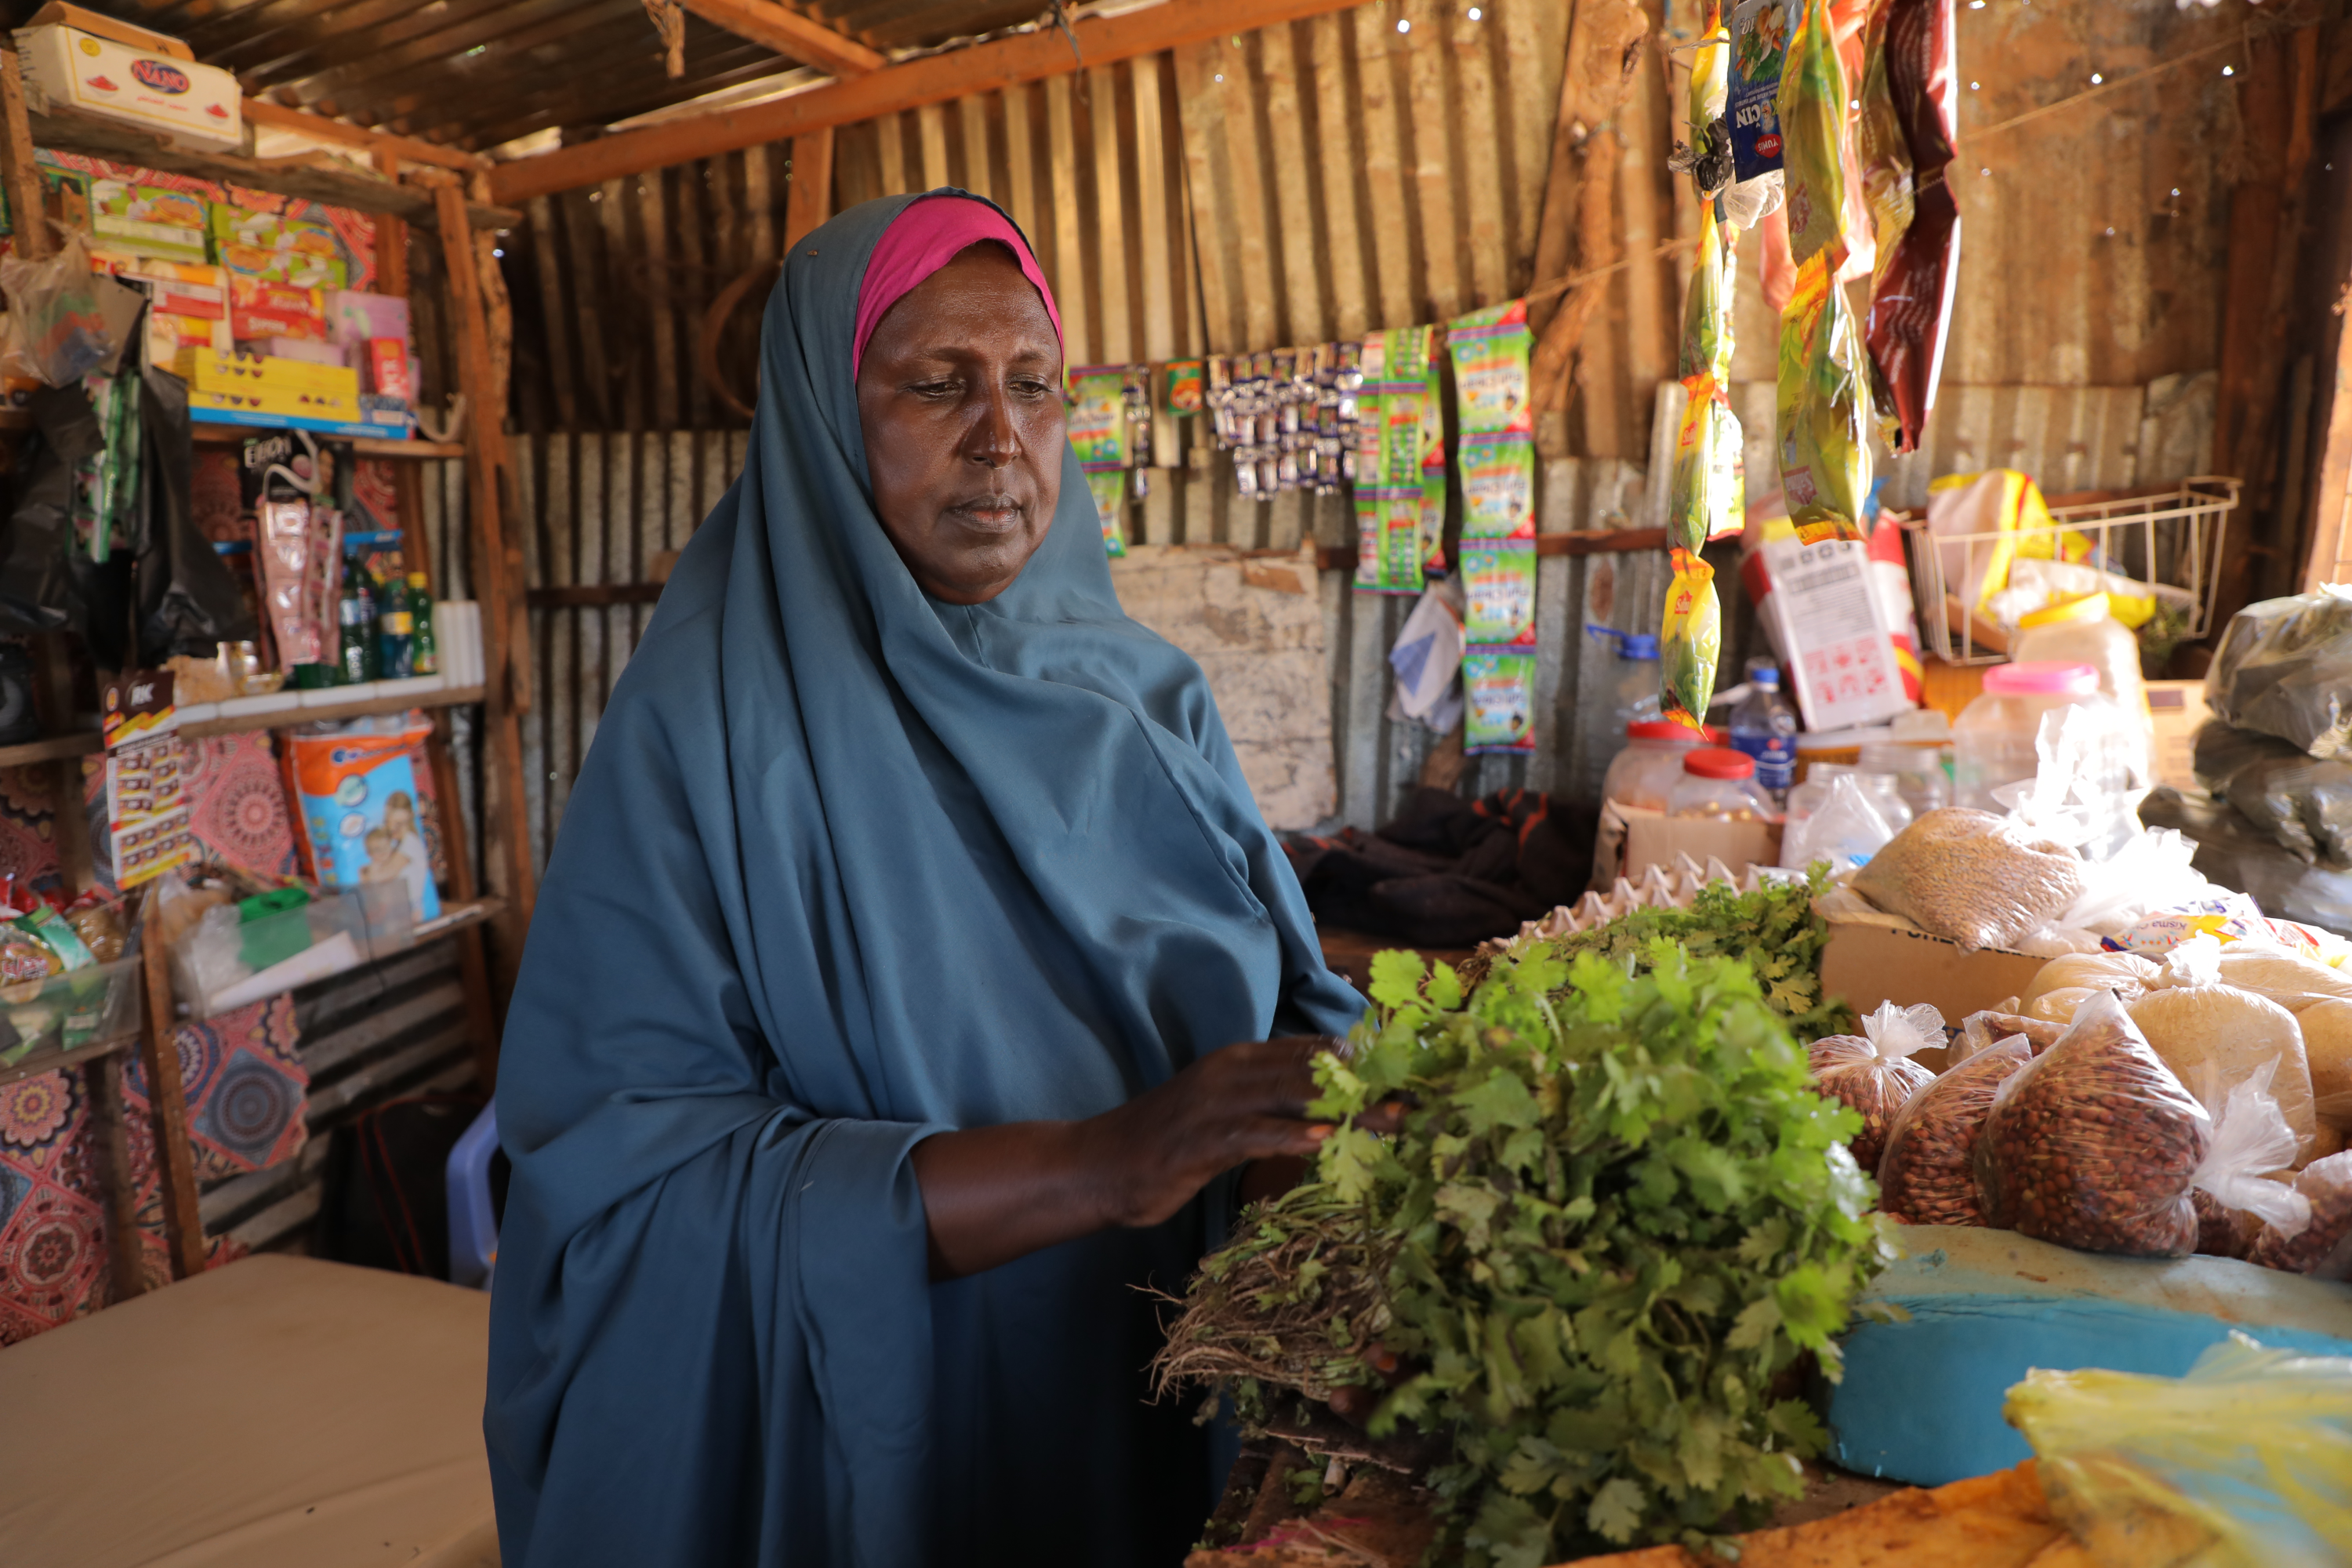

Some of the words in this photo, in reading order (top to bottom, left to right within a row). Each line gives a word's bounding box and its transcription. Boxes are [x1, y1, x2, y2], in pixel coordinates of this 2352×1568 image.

[132, 58, 189, 92] NANO
[1758, 137, 1779, 152] YUMIS
[2152, 920, 2187, 931] Kisma
